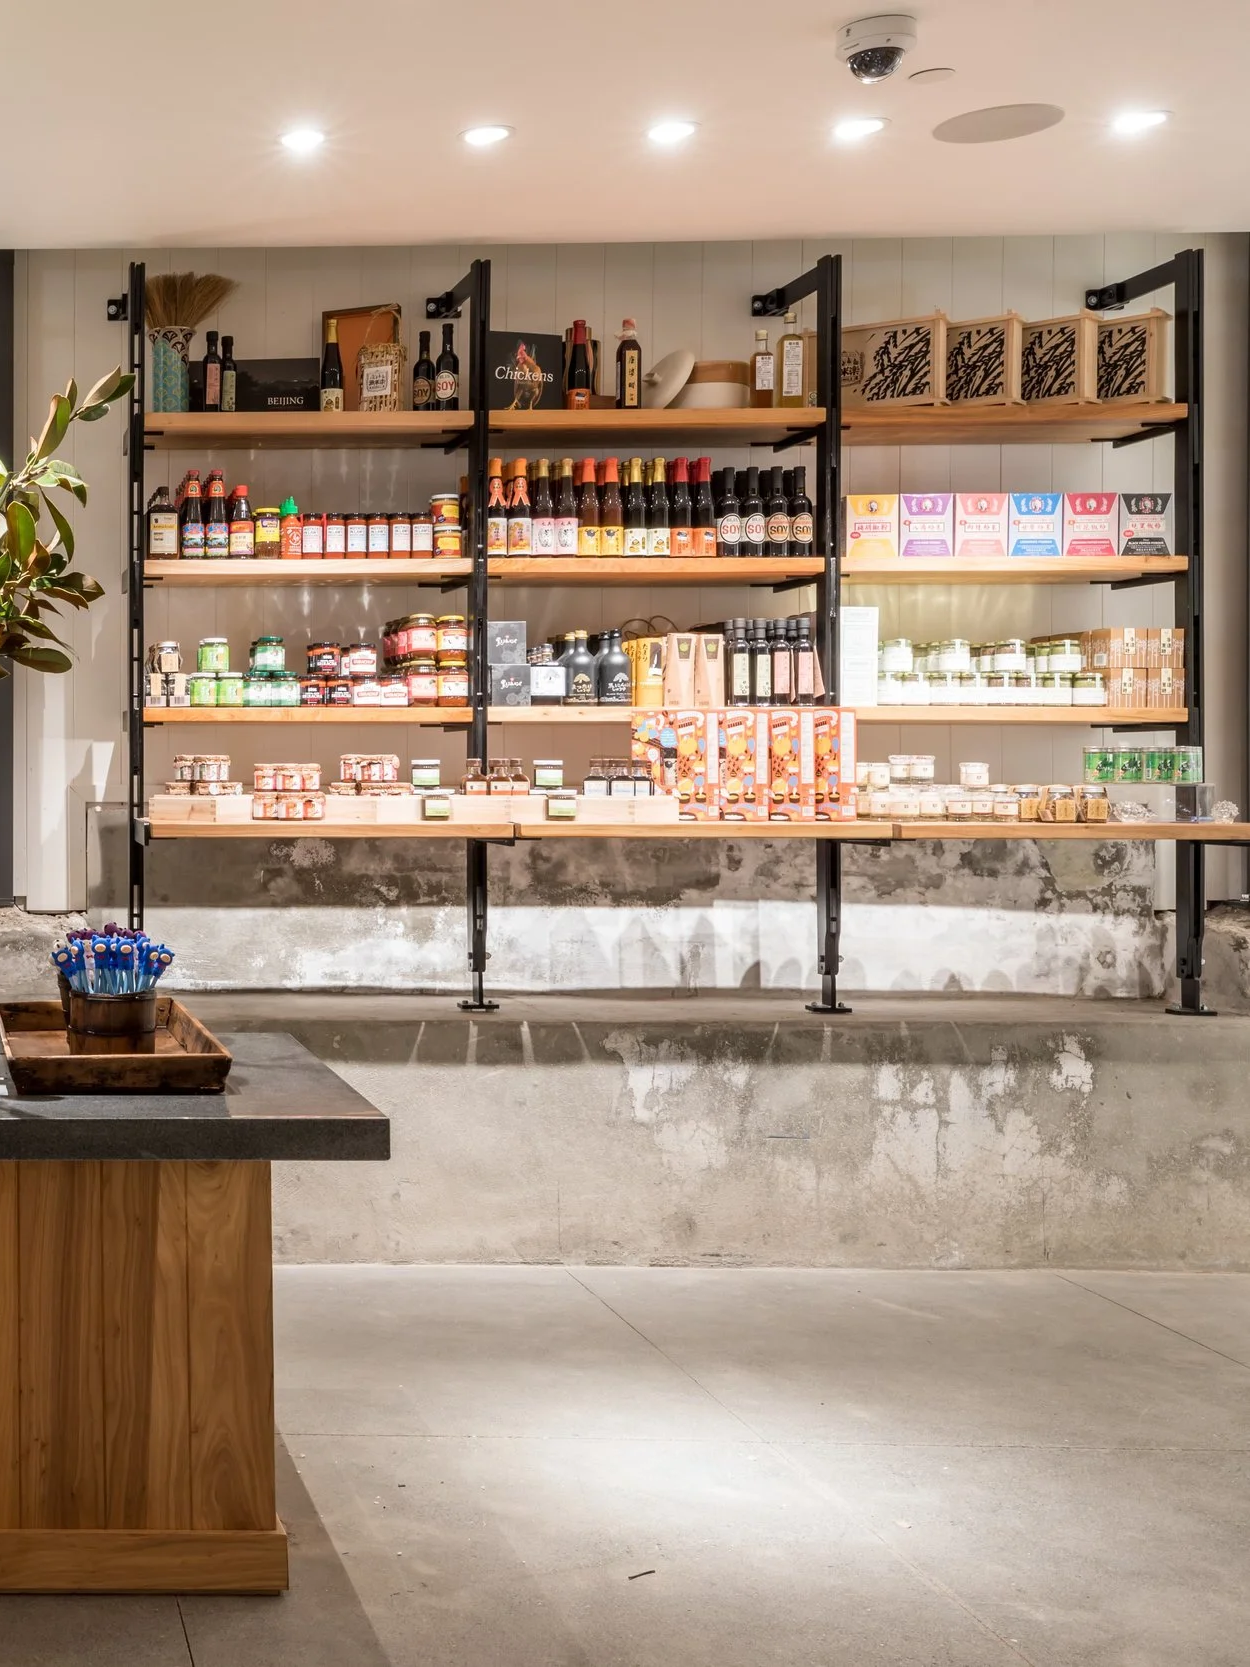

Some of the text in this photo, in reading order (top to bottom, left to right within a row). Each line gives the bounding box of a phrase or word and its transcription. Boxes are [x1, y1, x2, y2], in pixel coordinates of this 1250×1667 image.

[494, 366, 554, 383] Chickens
[437, 381, 454, 392] SOY
[267, 396, 304, 406] BEIJING
[722, 525, 740, 535] SOY
[770, 525, 788, 535] SOY
